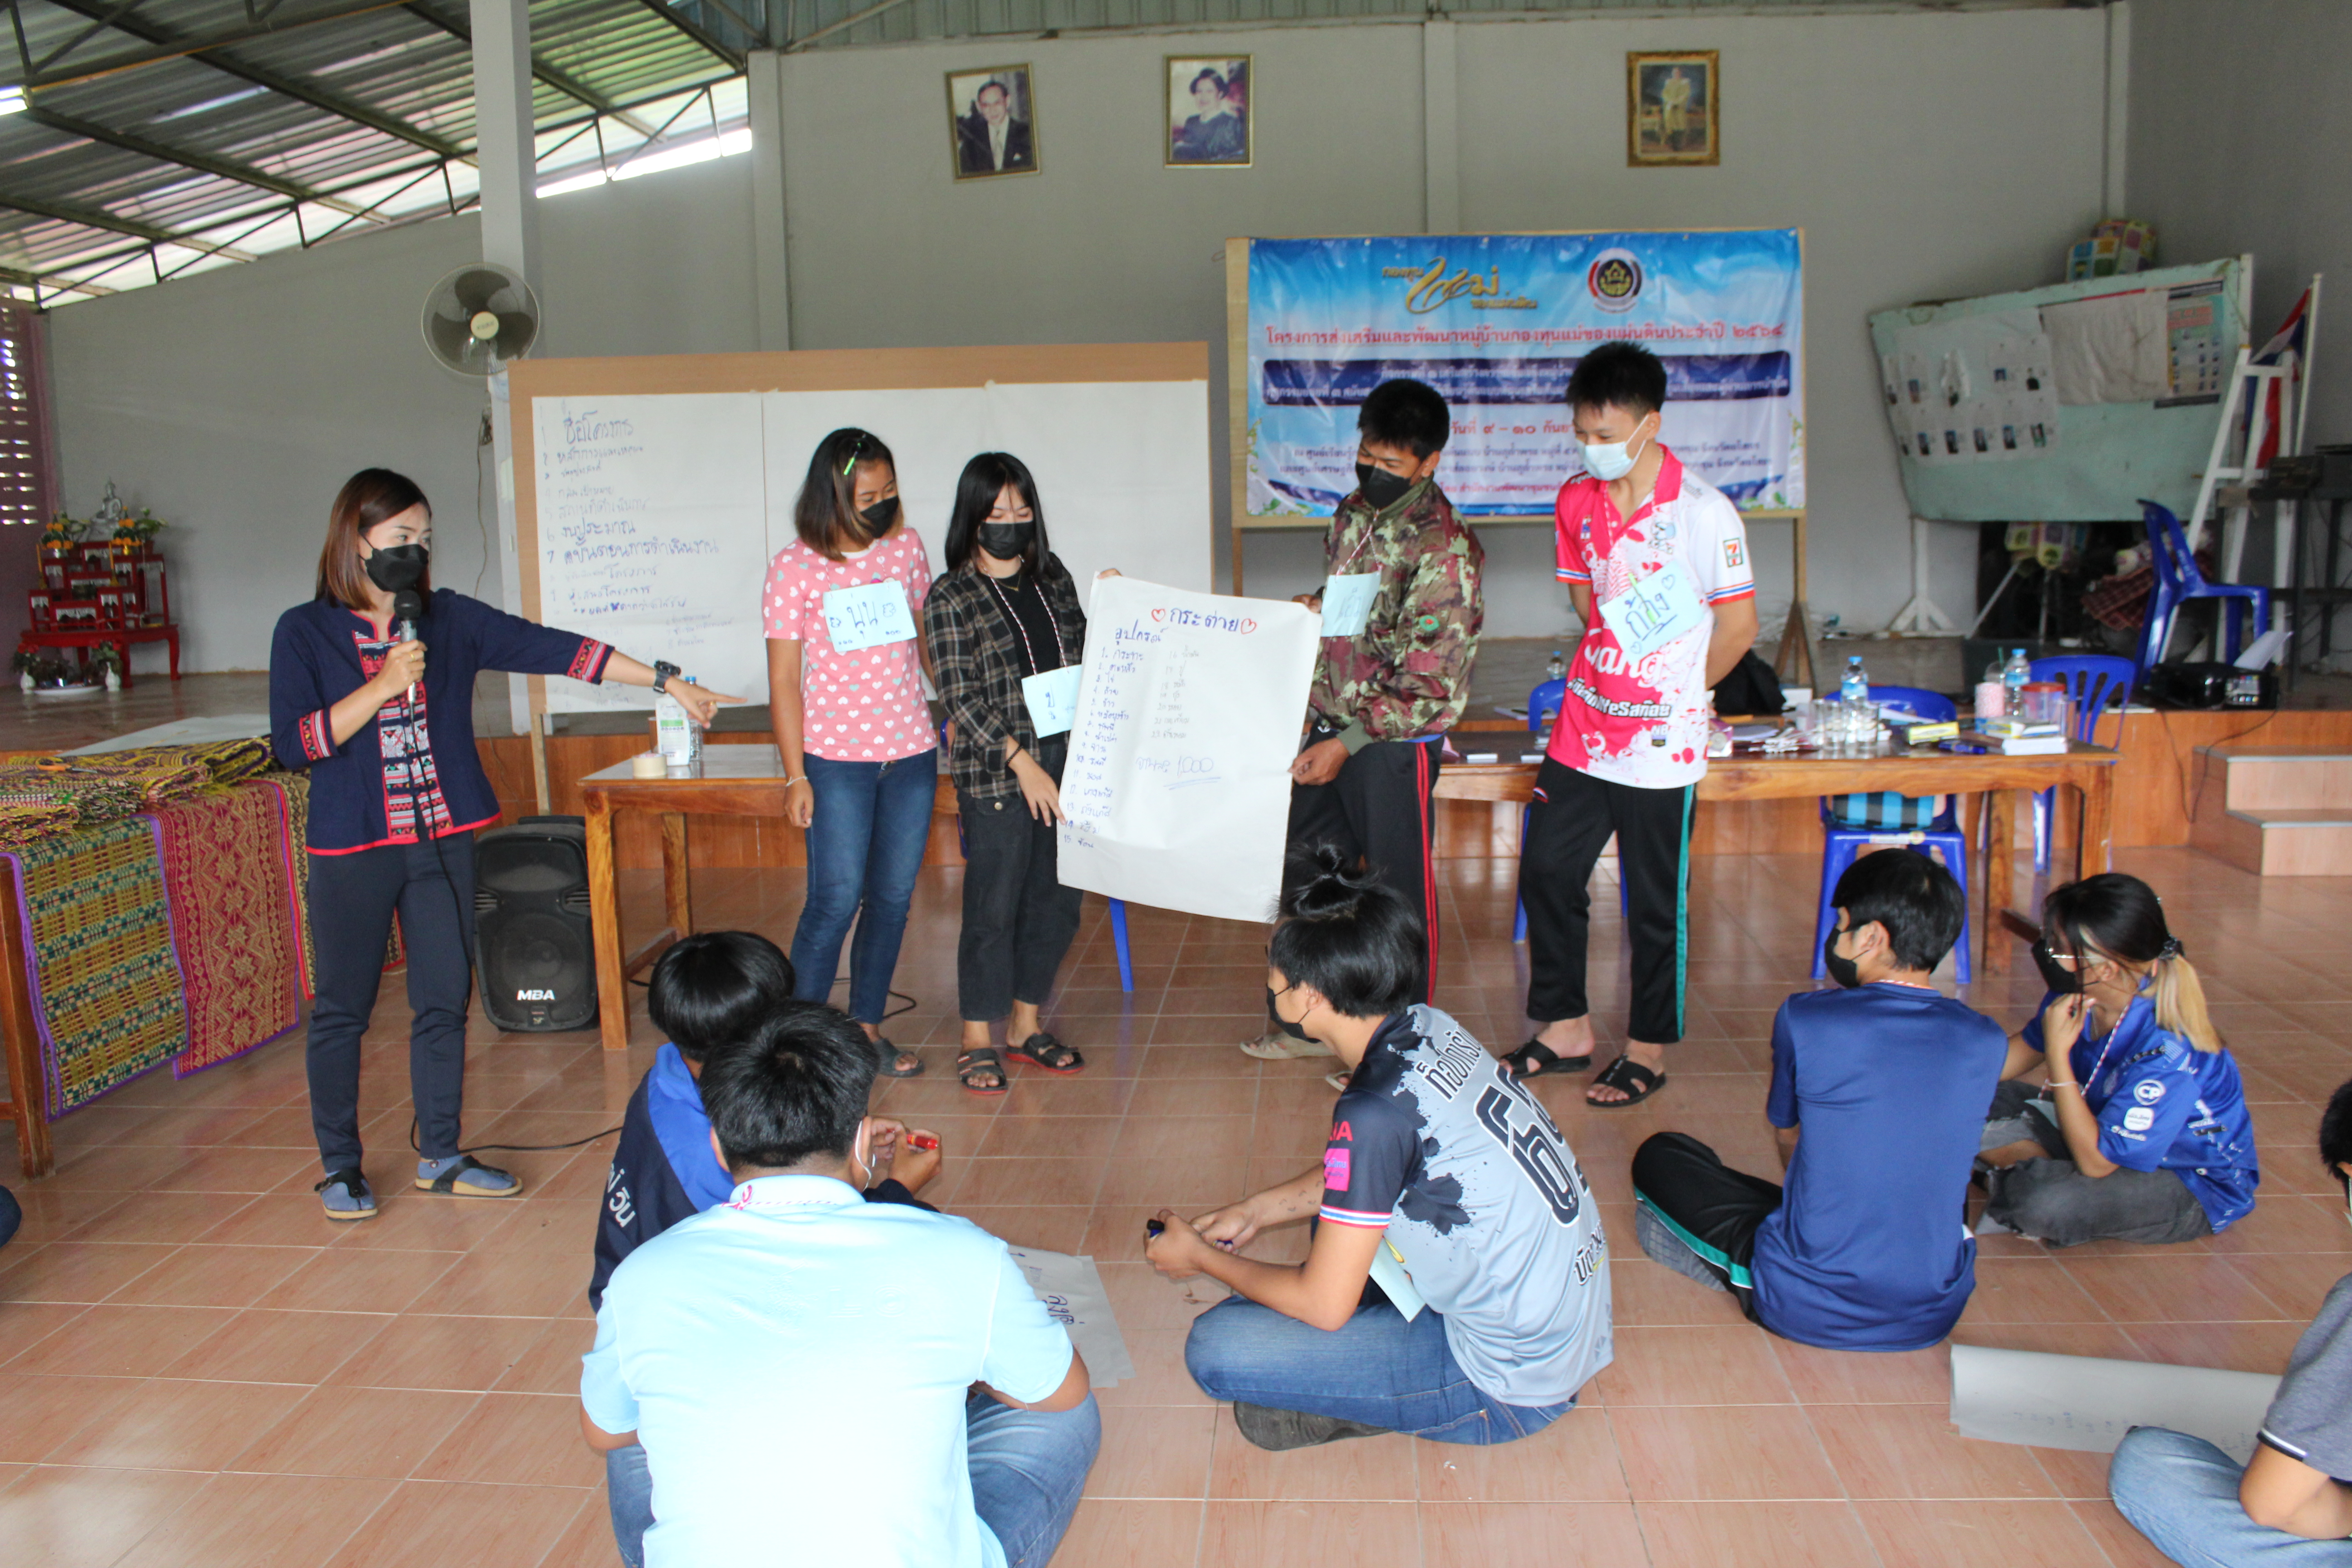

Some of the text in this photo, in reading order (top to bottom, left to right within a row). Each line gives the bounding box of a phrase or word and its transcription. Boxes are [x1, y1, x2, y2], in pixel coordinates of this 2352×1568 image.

[547, 528, 554, 541] 6
[1170, 608, 1239, 632] กระต่าย
[516, 990, 555, 1001] MBA
[2137, 1084, 2163, 1100] CP
